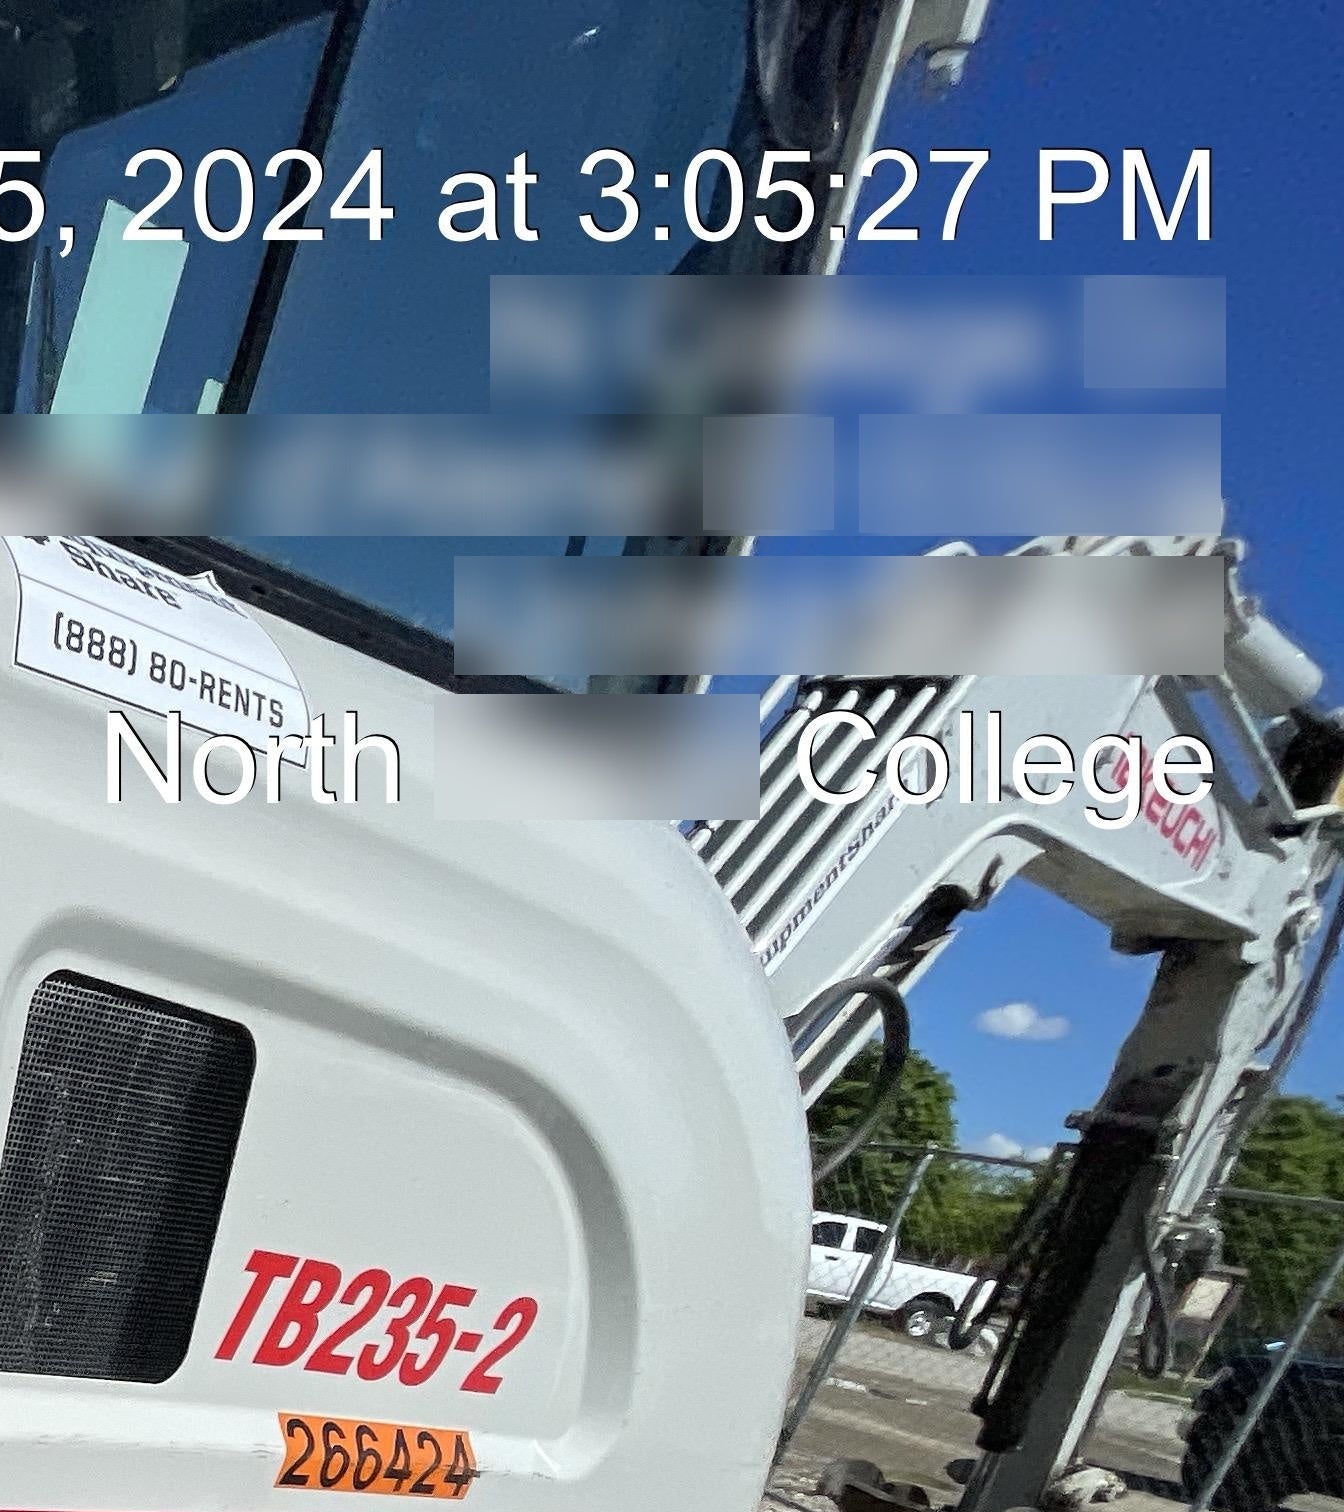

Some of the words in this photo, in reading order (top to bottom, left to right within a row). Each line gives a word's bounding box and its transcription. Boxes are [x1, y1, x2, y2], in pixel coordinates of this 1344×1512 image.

[53, 611, 138, 676] (888)
[149, 652, 285, 729] 80-RENTS
[214, 1249, 539, 1394] TB235-2
[278, 1418, 481, 1495] 266424
